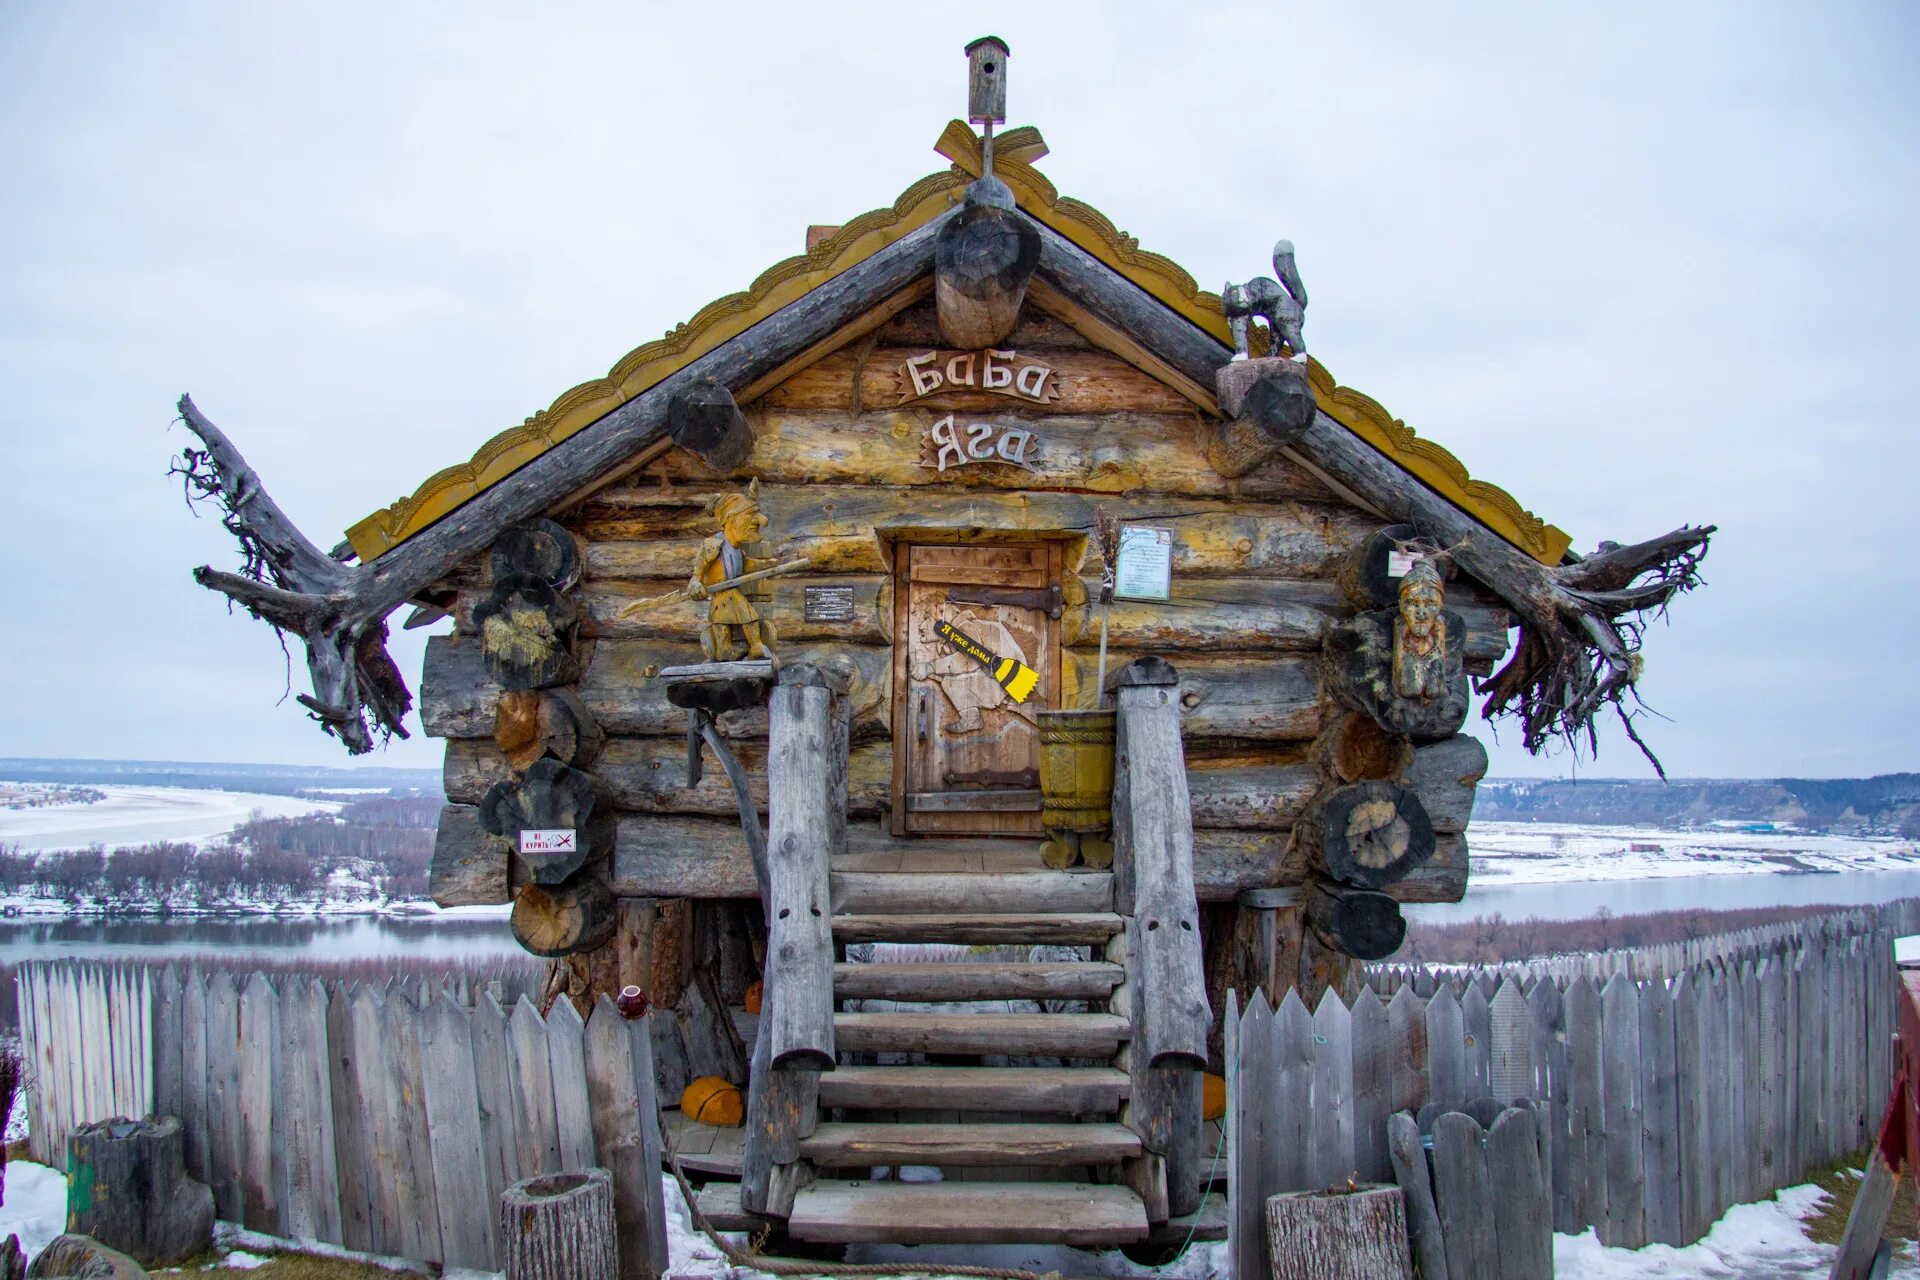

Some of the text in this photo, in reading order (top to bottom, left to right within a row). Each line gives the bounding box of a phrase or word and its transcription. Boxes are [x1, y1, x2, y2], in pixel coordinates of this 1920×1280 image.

[941, 624, 991, 664] Я уже дома
